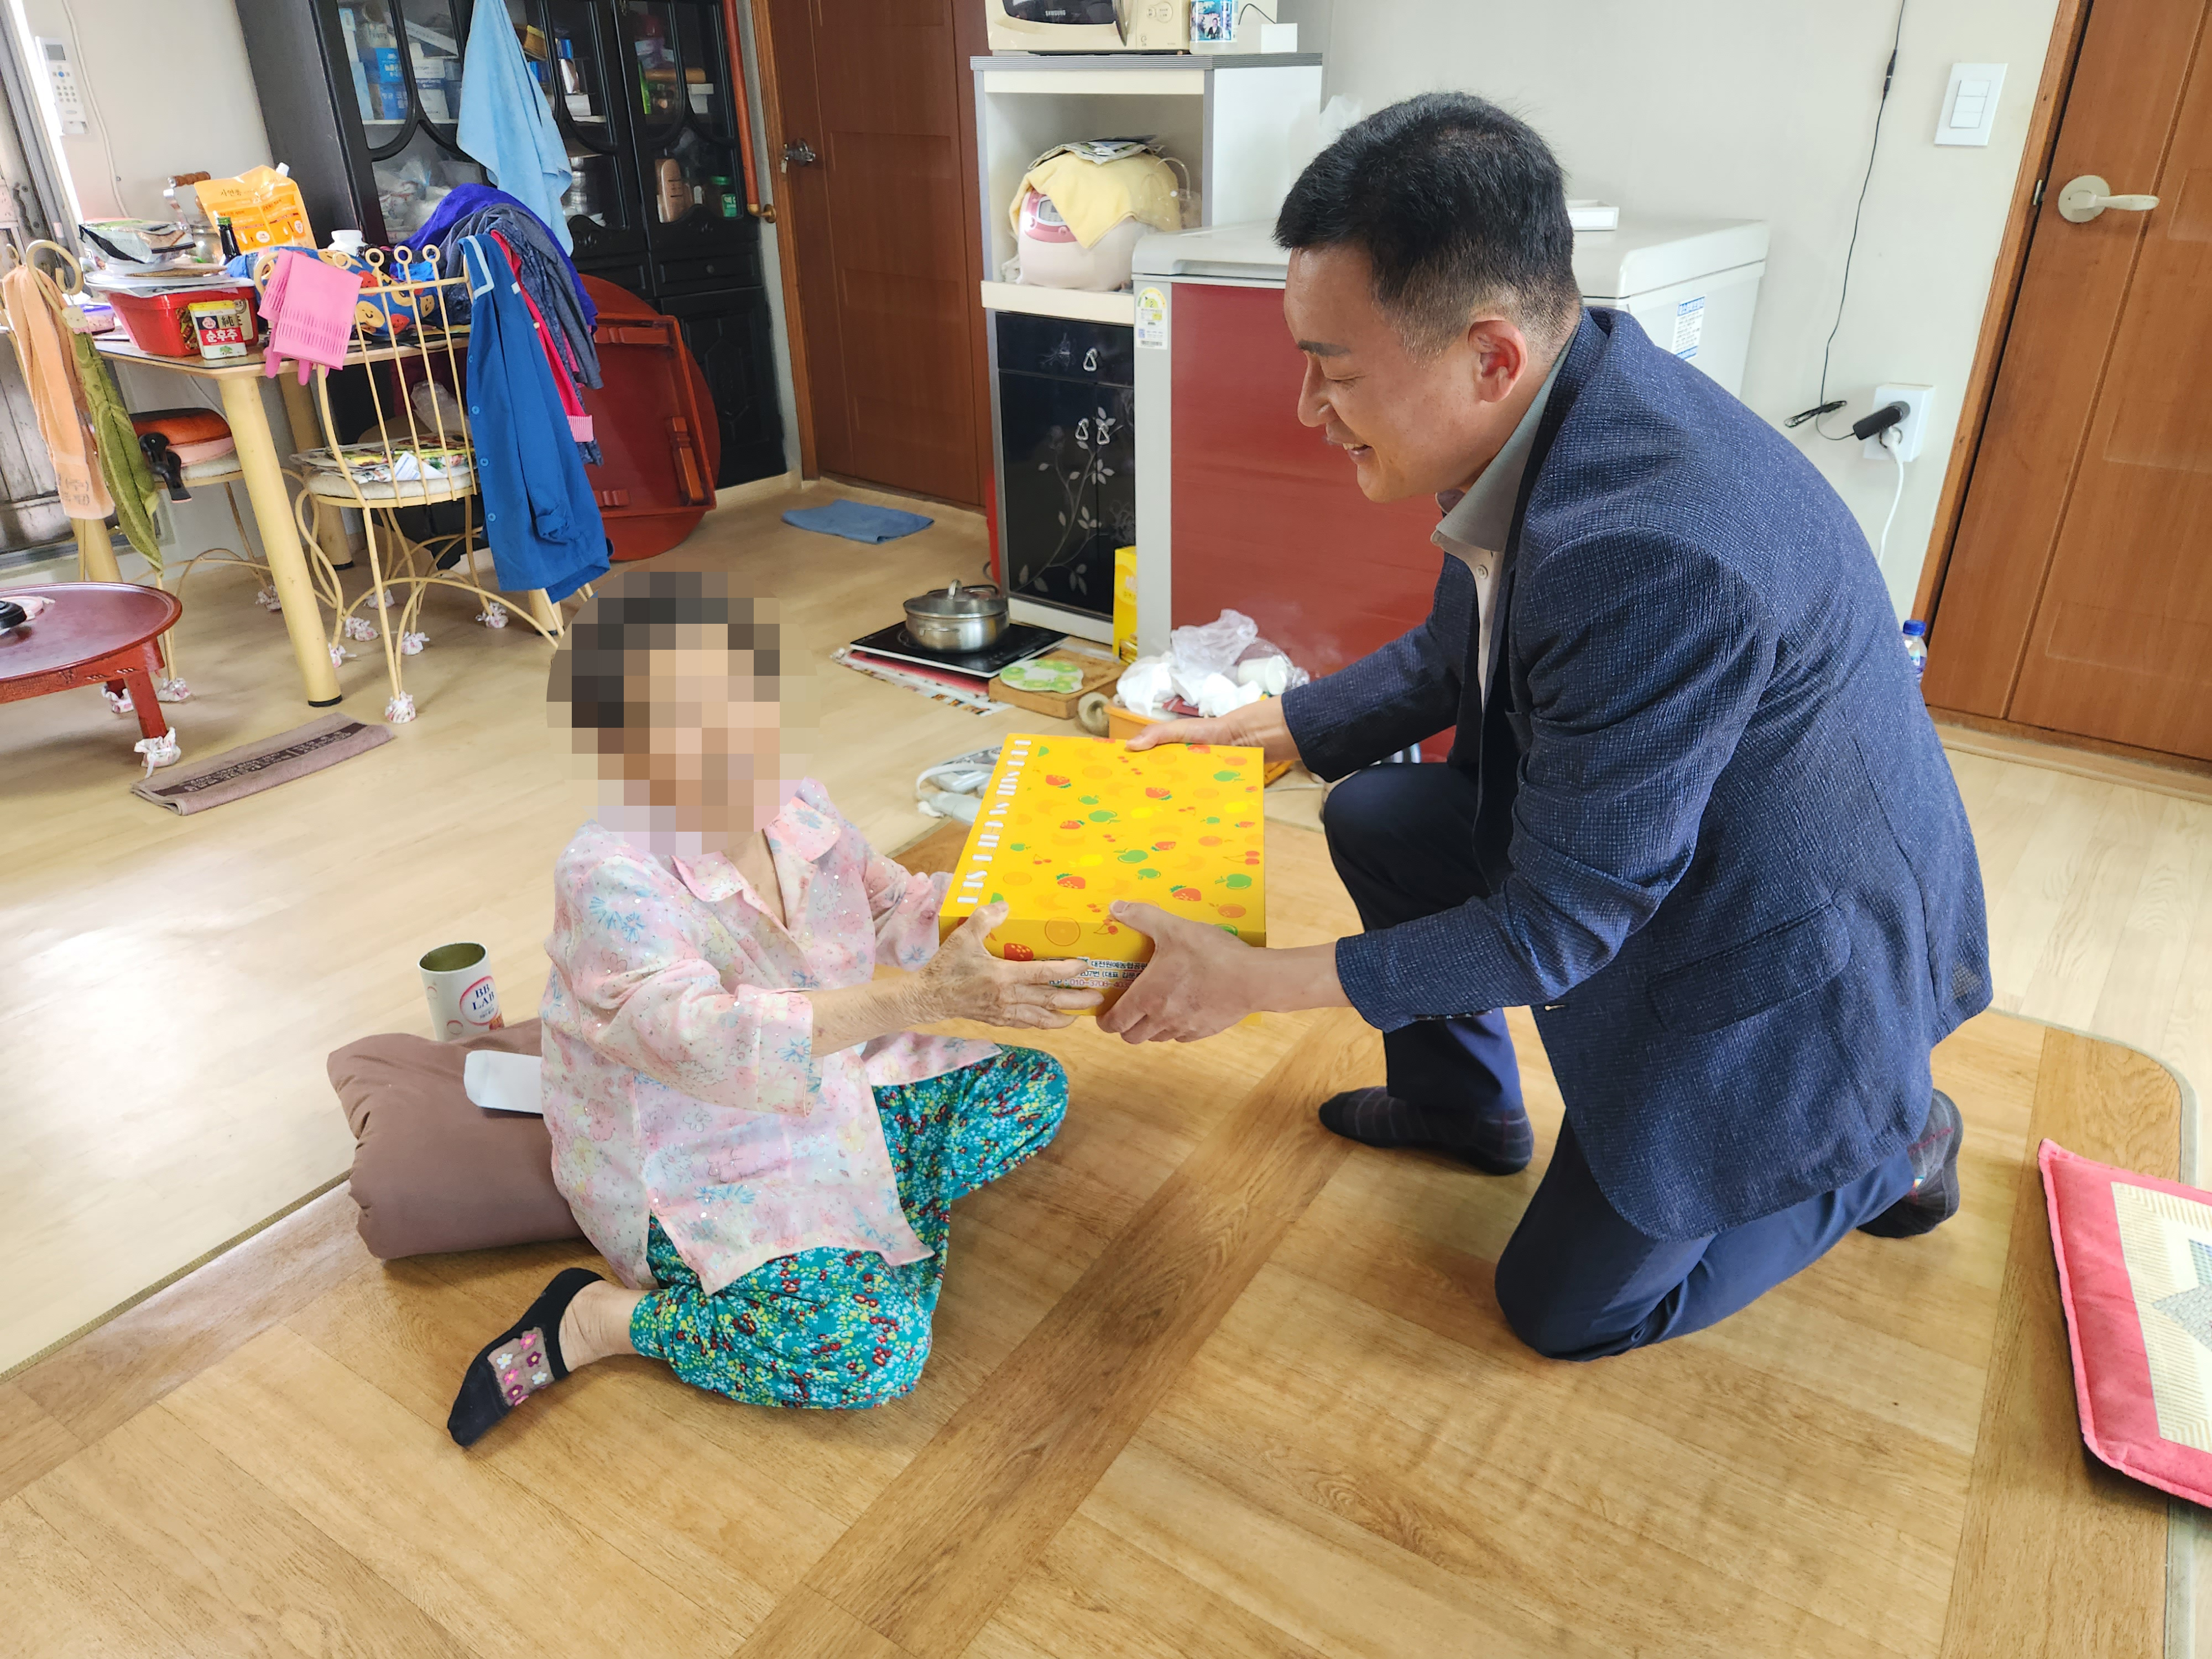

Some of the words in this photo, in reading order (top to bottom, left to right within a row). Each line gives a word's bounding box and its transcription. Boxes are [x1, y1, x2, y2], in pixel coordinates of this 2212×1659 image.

[207, 328, 238, 343] 순후추
[973, 821, 1003, 864] GIFT
[958, 871, 987, 906] SET
[476, 984, 489, 998] BB
[473, 992, 494, 1010] LAB
